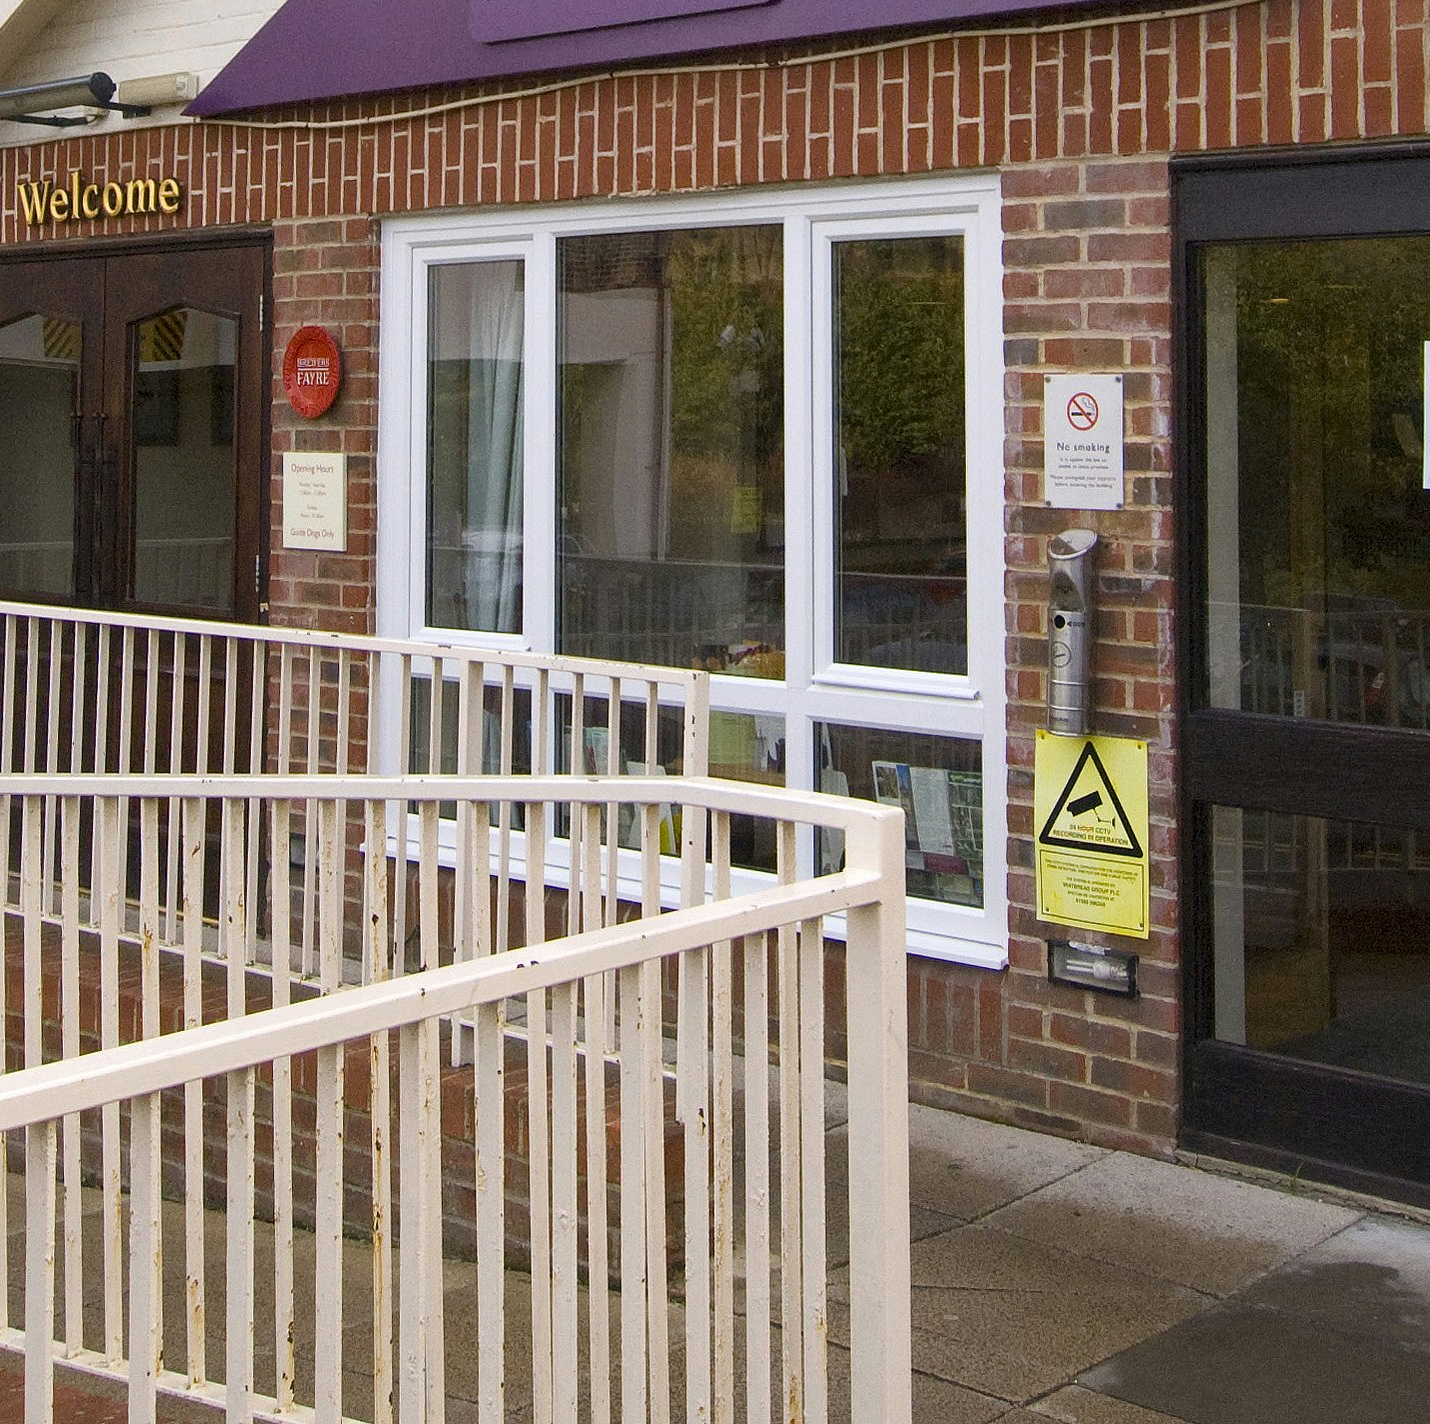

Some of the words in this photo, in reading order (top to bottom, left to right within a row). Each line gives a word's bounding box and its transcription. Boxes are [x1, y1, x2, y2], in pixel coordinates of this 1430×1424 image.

[17, 171, 180, 226] Welcome
[297, 371, 330, 386] FAYRE
[1056, 442, 1070, 451] No
[1074, 442, 1110, 454] smoking
[291, 463, 315, 474] Opening
[316, 463, 334, 473] Hours
[307, 528, 320, 539] Dogs
[321, 529, 334, 539] Only
[1077, 825, 1094, 833] HOUR
[1095, 827, 1111, 835] CCTV
[1053, 829, 1087, 840] RECORDING
[1094, 835, 1129, 846] OPERATION
